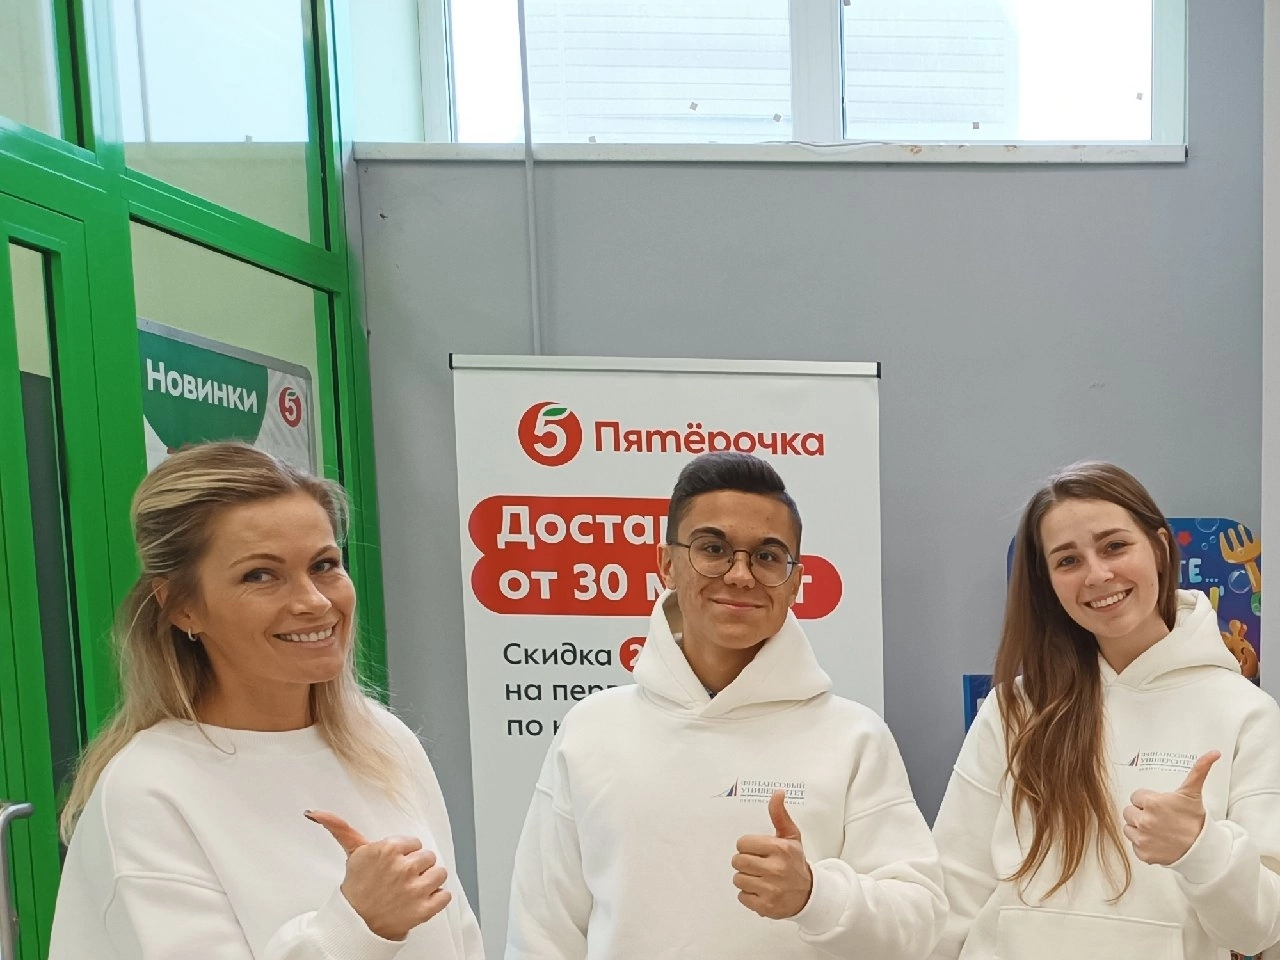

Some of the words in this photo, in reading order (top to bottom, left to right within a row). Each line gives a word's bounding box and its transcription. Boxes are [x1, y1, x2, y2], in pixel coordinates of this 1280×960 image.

[146, 358, 258, 414] Новинки
[282, 390, 299, 424] 5
[528, 403, 572, 460] 5
[594, 411, 825, 456] Пятёрочка
[499, 569, 557, 600] от
[573, 563, 628, 601] 30
[503, 642, 612, 666] Скидка
[505, 684, 542, 700] на
[553, 684, 621, 701] пер
[508, 719, 543, 736] по
